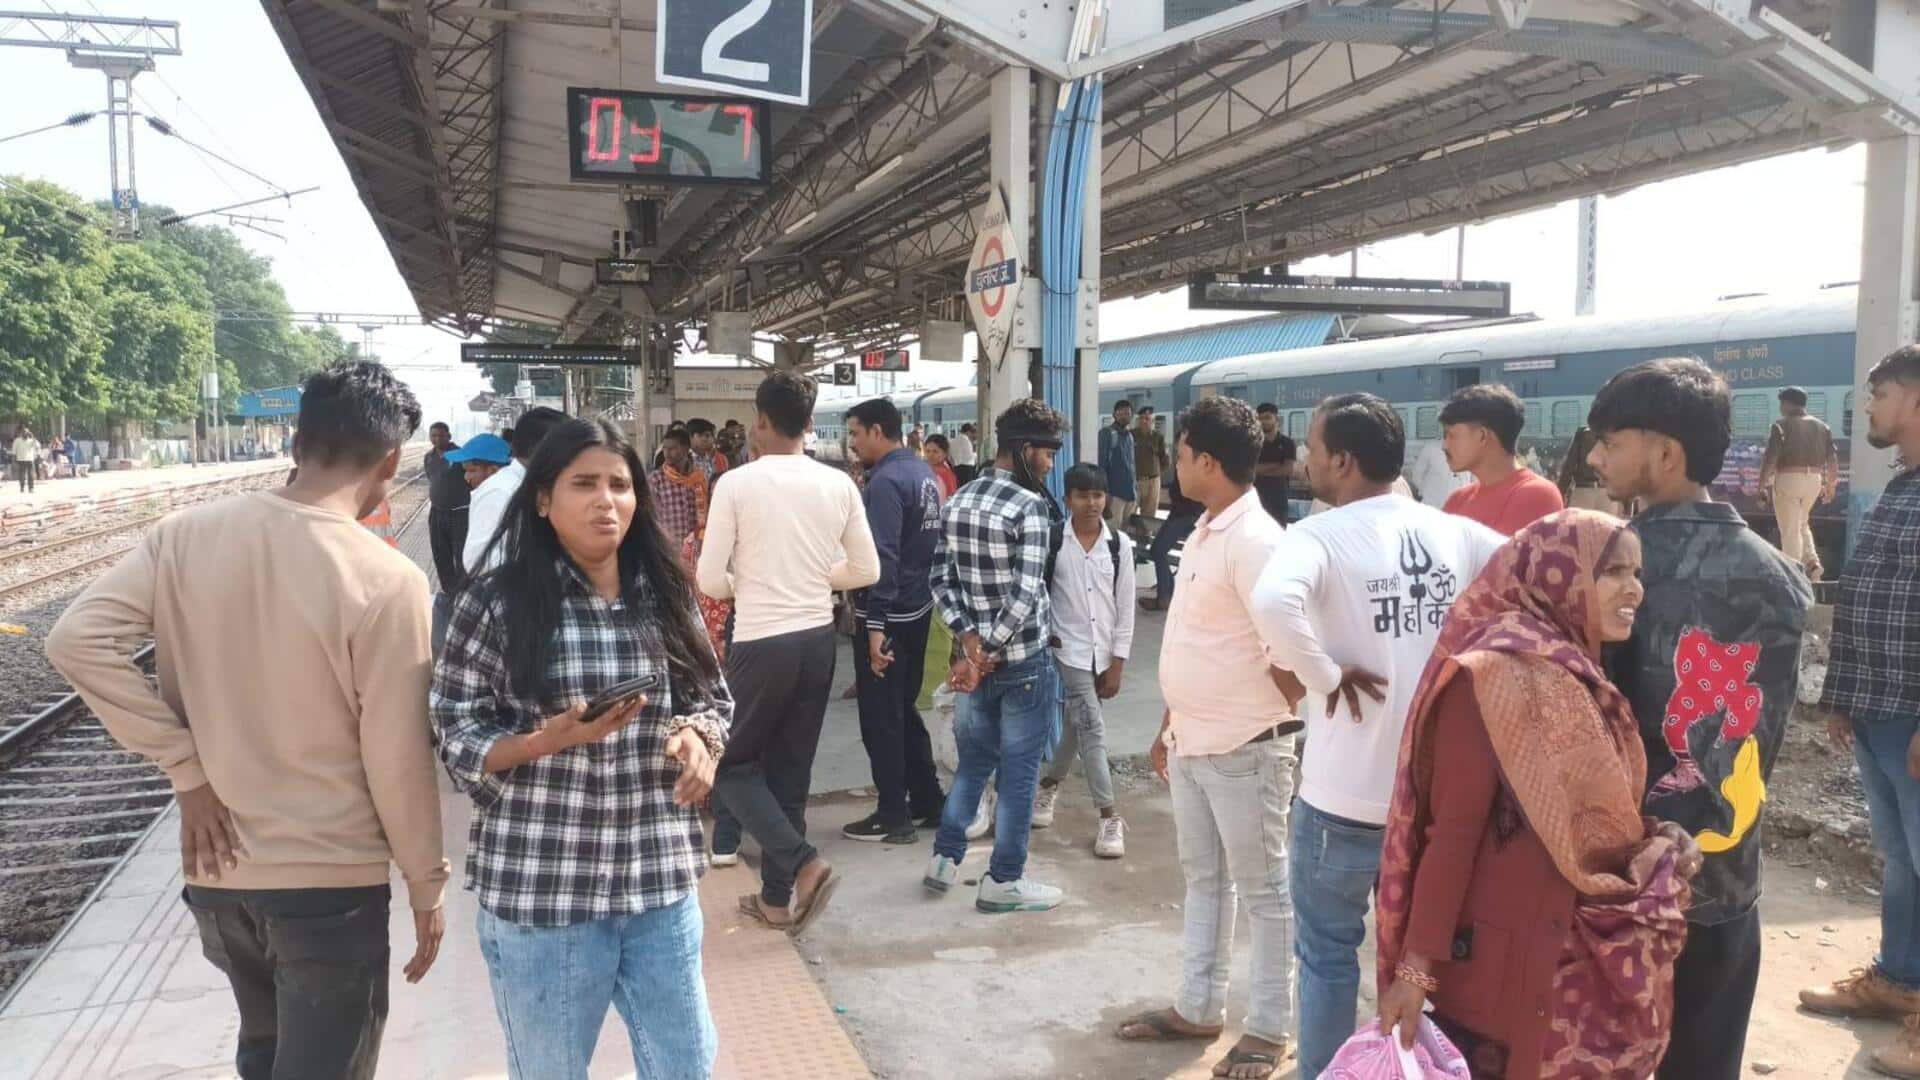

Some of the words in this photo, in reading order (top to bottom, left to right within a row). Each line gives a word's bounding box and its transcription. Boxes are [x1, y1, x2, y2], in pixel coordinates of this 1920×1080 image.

[701, 0, 771, 82] 2
[839, 366, 853, 383] 3
[1741, 366, 1784, 380] CLASS
